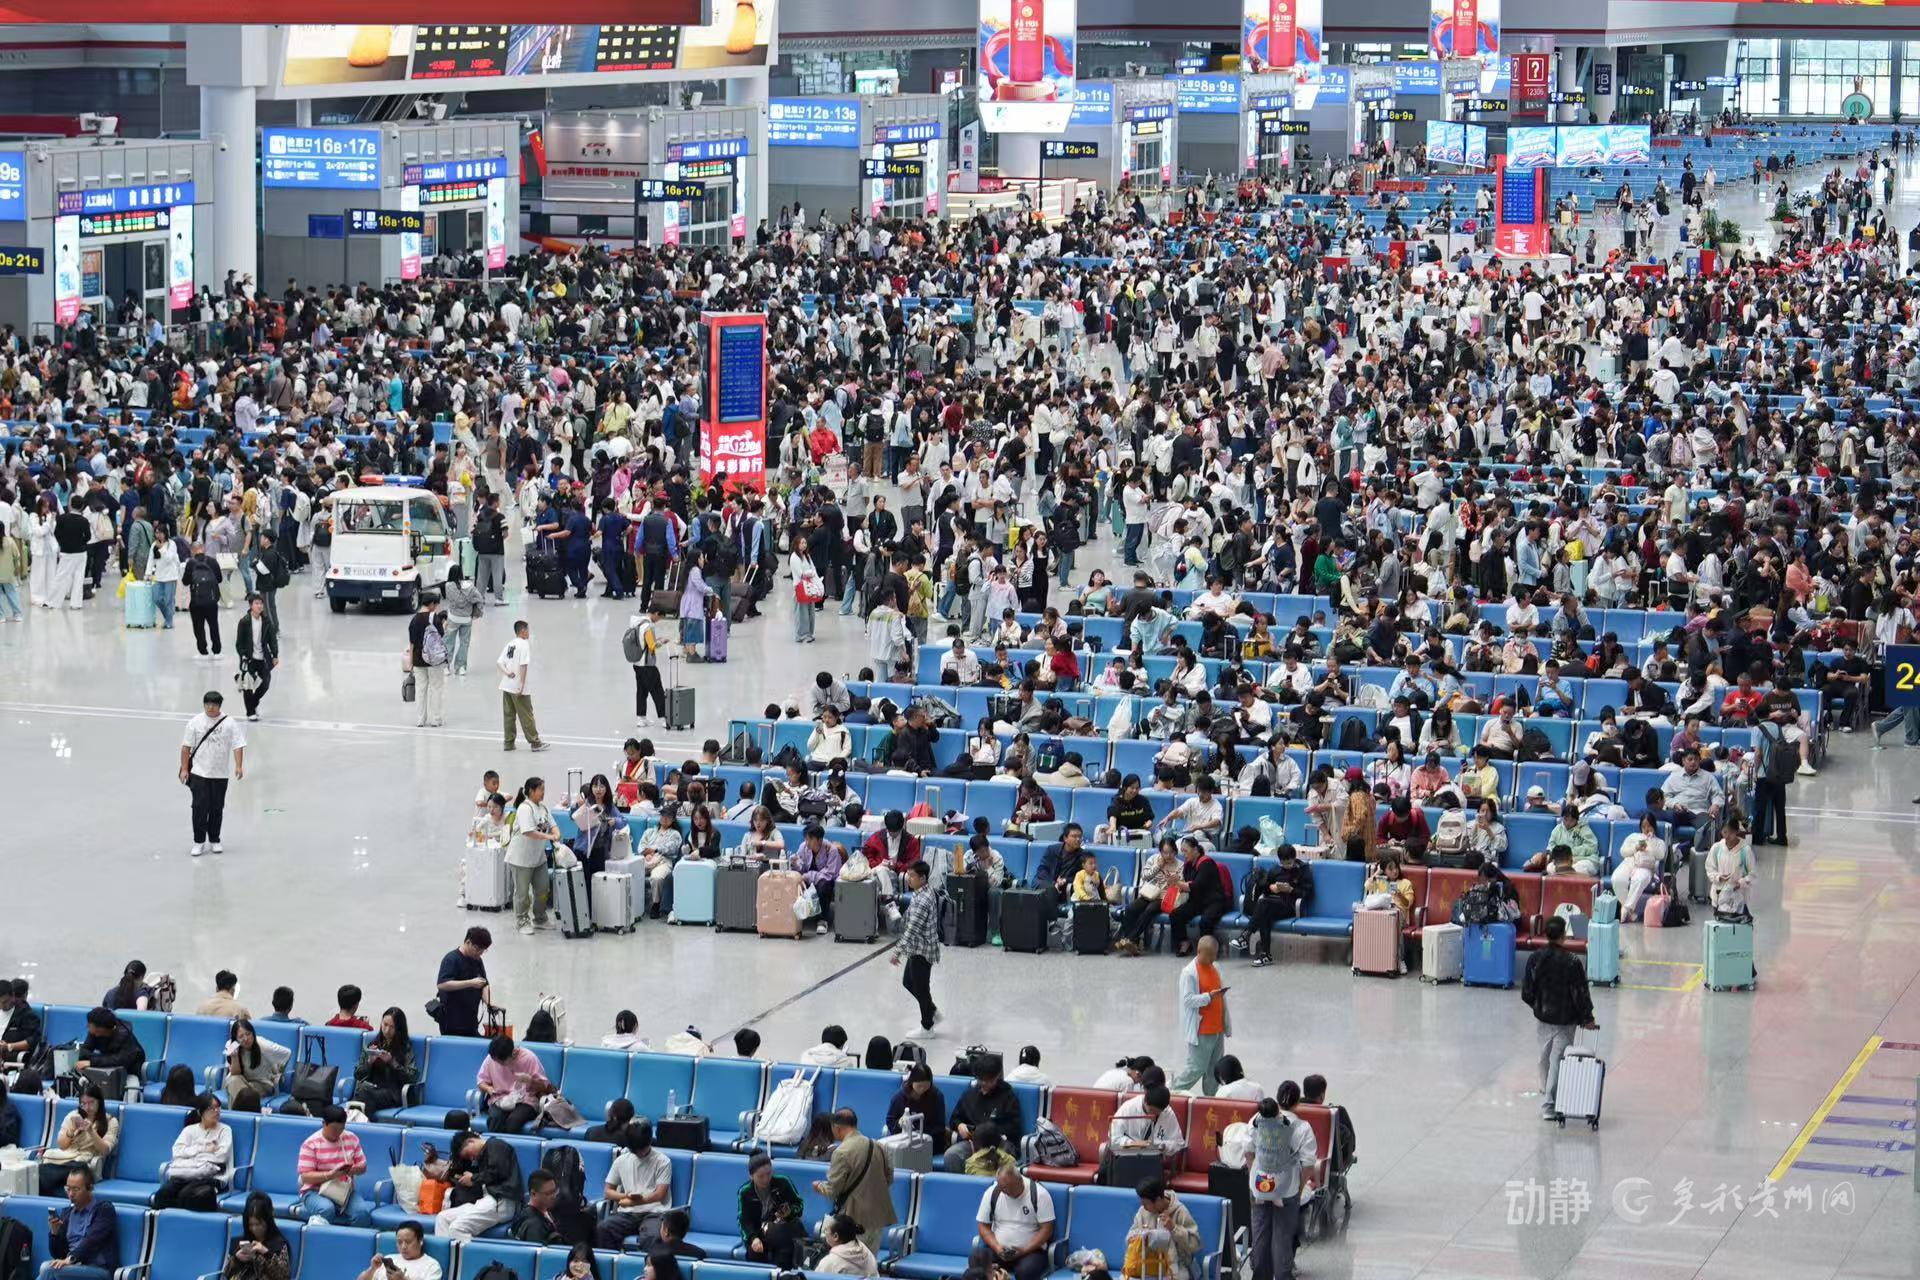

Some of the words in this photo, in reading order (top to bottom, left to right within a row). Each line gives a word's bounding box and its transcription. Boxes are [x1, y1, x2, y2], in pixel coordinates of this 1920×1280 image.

[1201, 79, 1235, 93] 8B·9B
[1527, 88, 1544, 96] 12306
[1482, 101, 1505, 110] 6B·7B
[806, 106, 857, 120] 12B·13B
[1389, 111, 1413, 120] 8B·9B
[314, 137, 376, 155] 16B·17B
[1065, 145, 1095, 154] 12B·13B
[887, 164, 920, 174] 14B·15B
[665, 185, 702, 197] 16B·17B
[378, 215, 420, 227] 18B·19B
